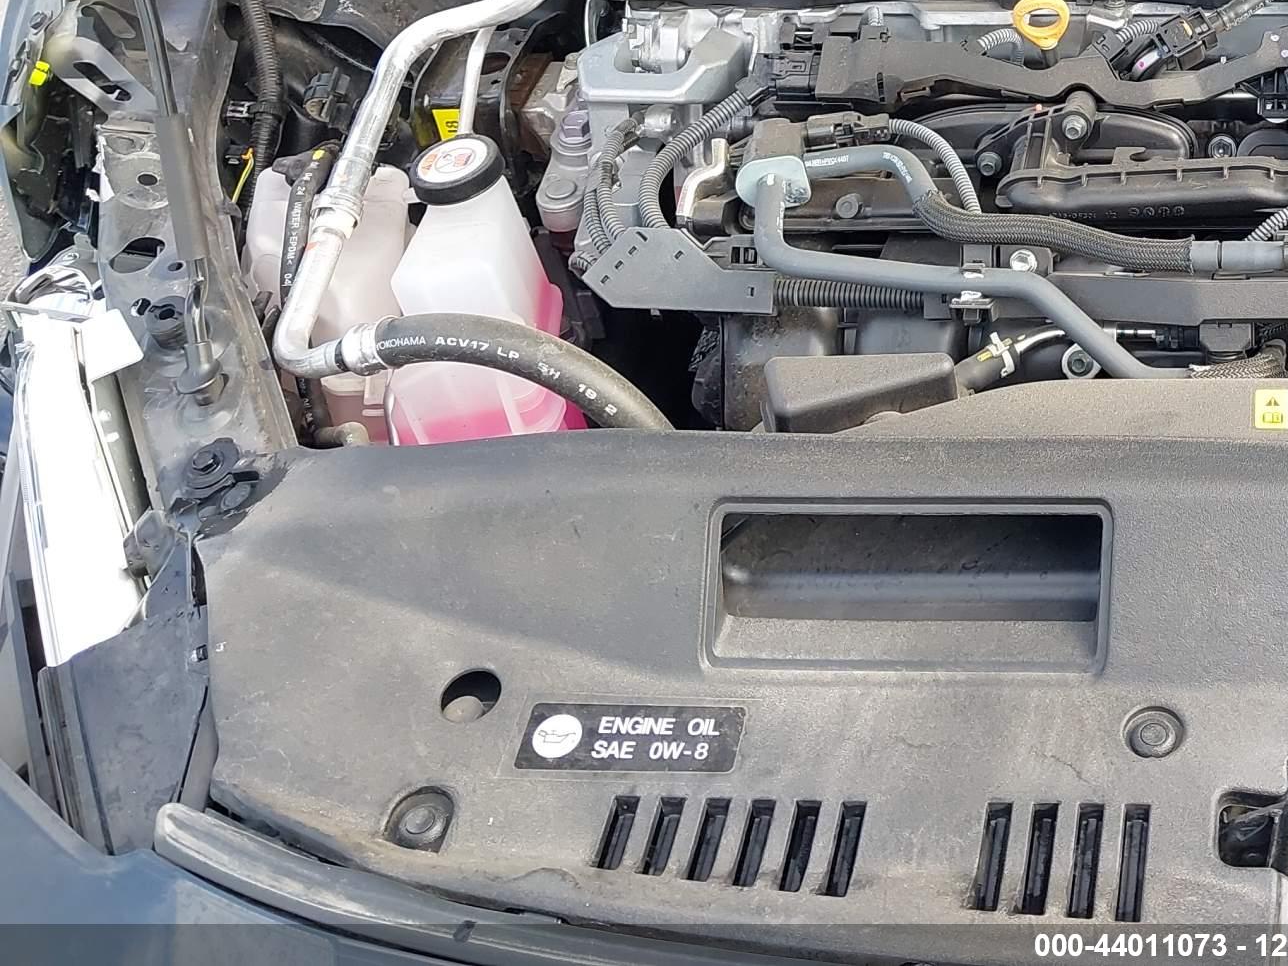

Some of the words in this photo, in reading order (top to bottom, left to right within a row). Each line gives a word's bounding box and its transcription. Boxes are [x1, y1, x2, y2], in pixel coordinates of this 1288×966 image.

[291, 201, 303, 229] WATER
[435, 336, 489, 351] ACV17
[497, 346, 520, 359] LP
[598, 716, 676, 735] ENGINE
[687, 718, 720, 736] OIL
[591, 740, 636, 759] SAE
[648, 741, 709, 760] 0W-8
